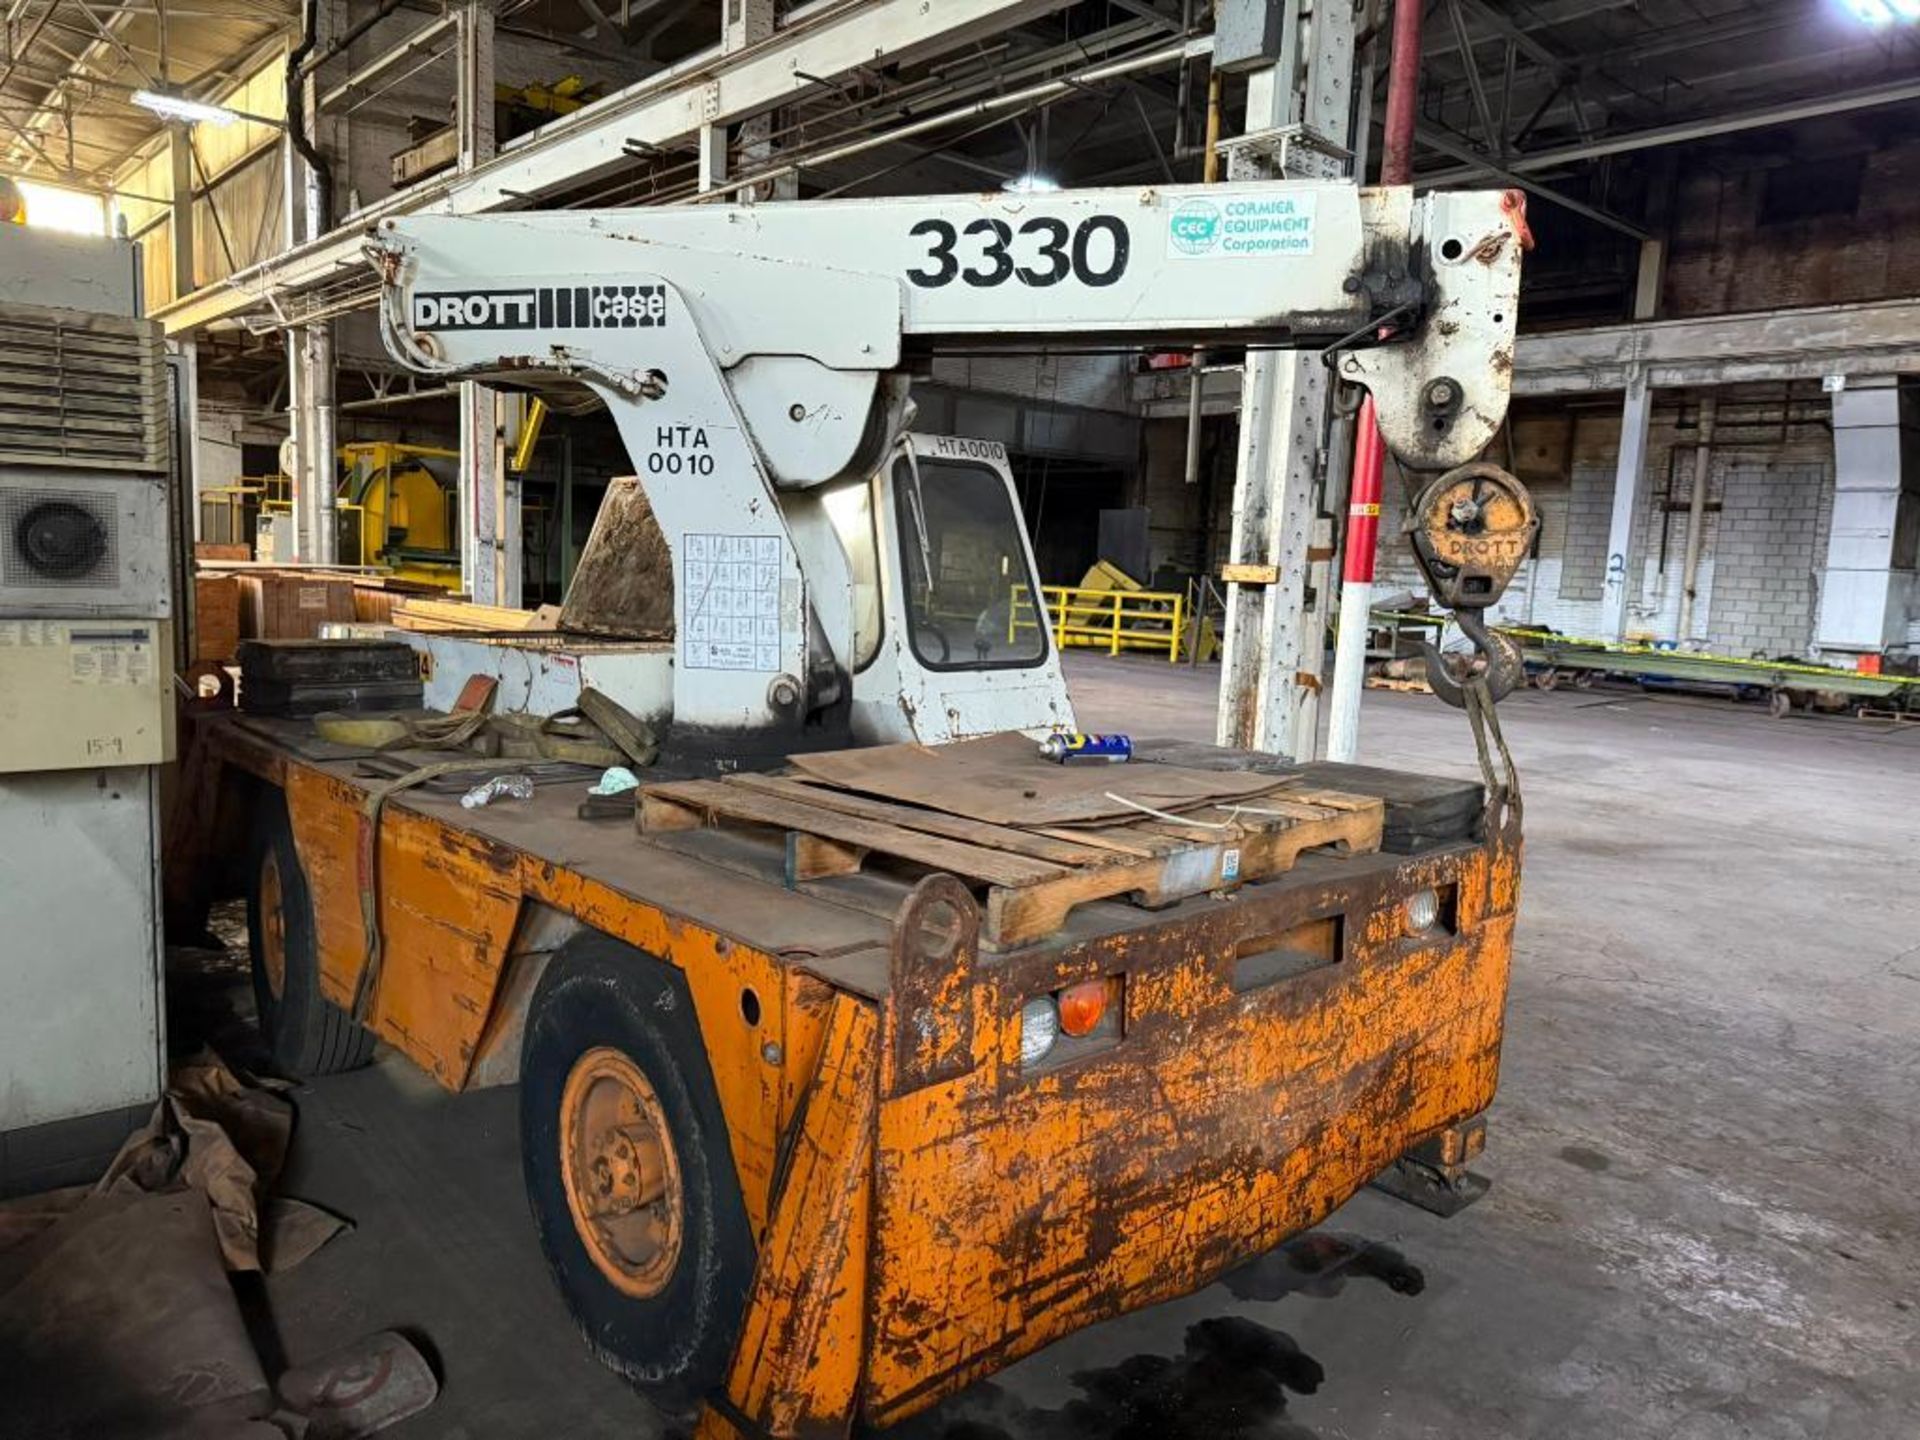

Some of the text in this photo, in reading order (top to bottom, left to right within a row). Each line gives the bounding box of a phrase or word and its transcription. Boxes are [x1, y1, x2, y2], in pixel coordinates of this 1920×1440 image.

[1224, 200, 1295, 216] CORMIER
[1223, 217, 1311, 233] EQUIPMENT
[905, 214, 1131, 288] 3330
[1222, 236, 1309, 252] Corporation
[414, 290, 665, 327] DROTT case
[657, 426, 709, 448] HTA
[648, 452, 714, 476] 0010
[1450, 540, 1518, 555] DROTT
